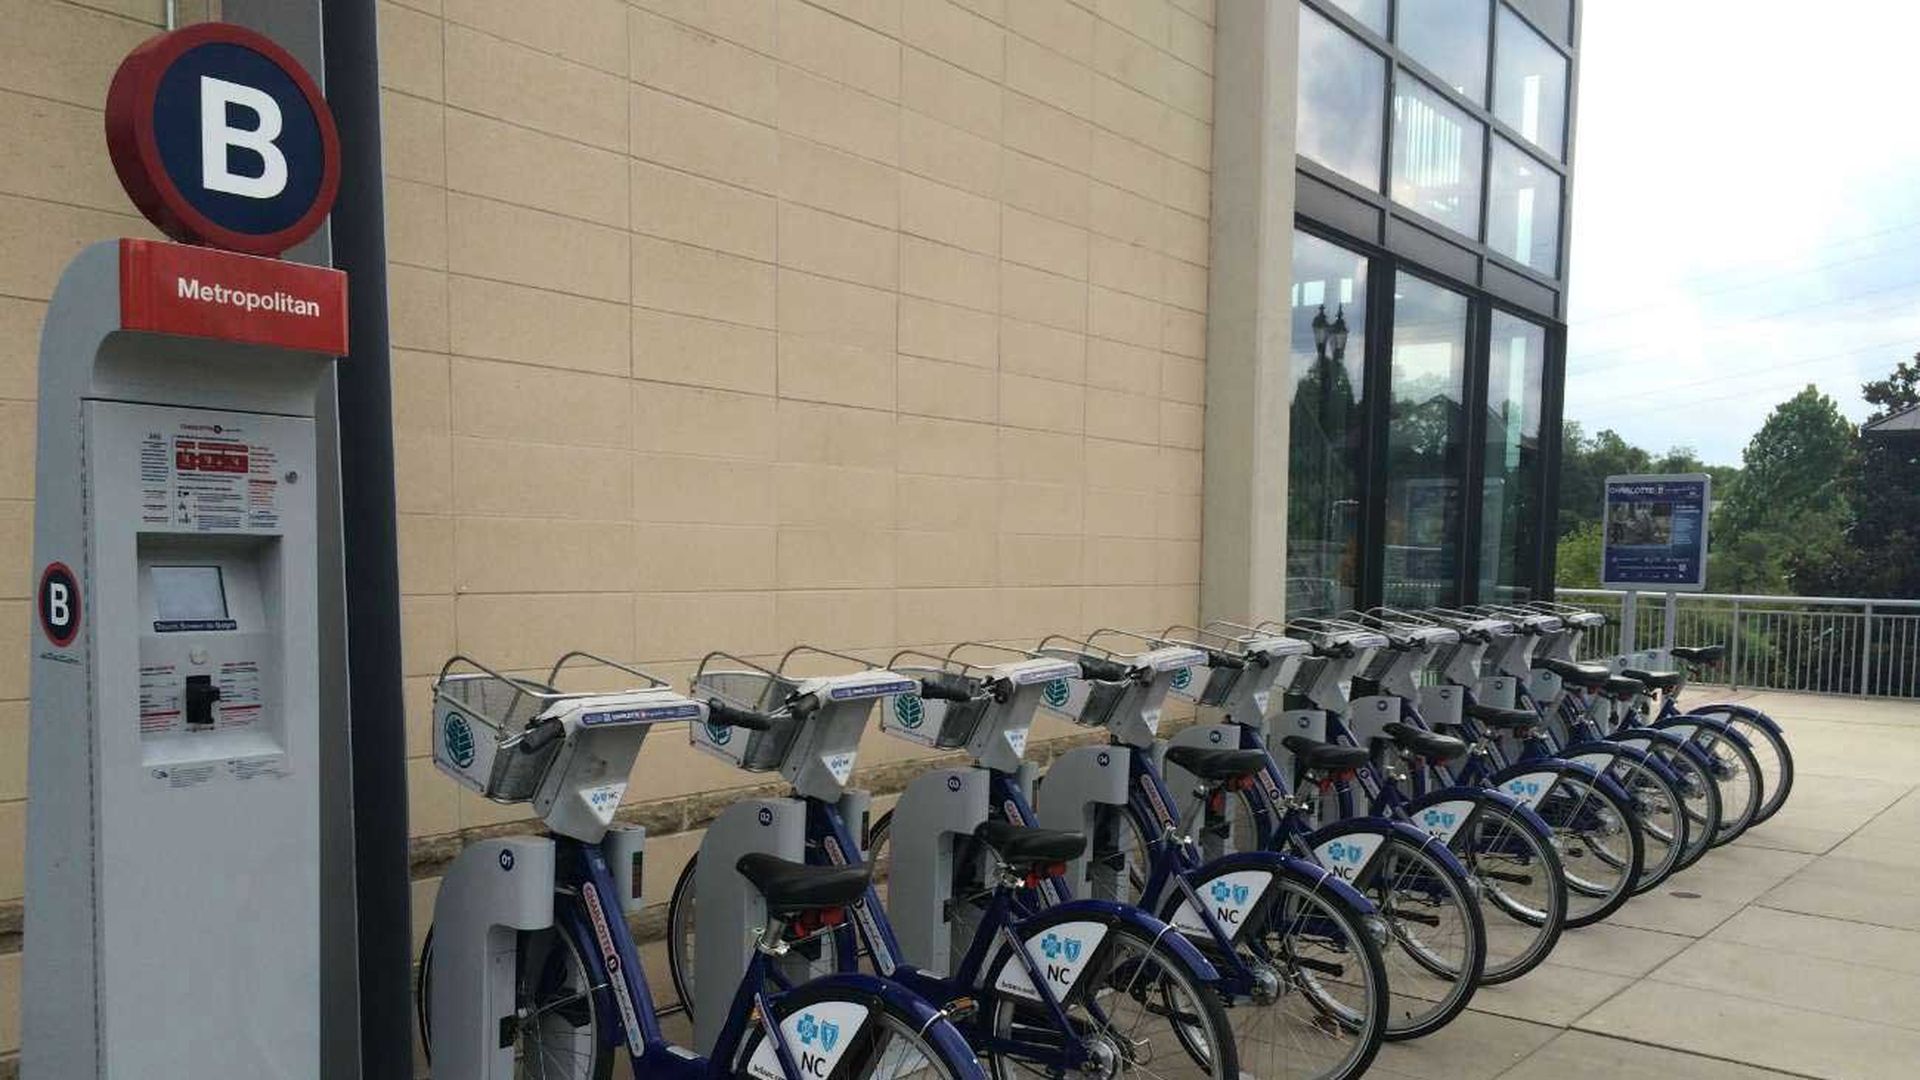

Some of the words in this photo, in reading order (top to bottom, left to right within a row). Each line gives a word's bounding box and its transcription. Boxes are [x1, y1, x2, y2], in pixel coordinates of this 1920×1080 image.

[199, 74, 289, 200] B
[177, 277, 321, 318] Metropolitan
[50, 582, 71, 626] B
[760, 811, 771, 822] 02
[501, 853, 512, 867] 01
[1333, 865, 1353, 880] NC
[1217, 907, 1239, 924] NC
[1046, 963, 1070, 985] NC
[801, 1050, 826, 1077] NC
